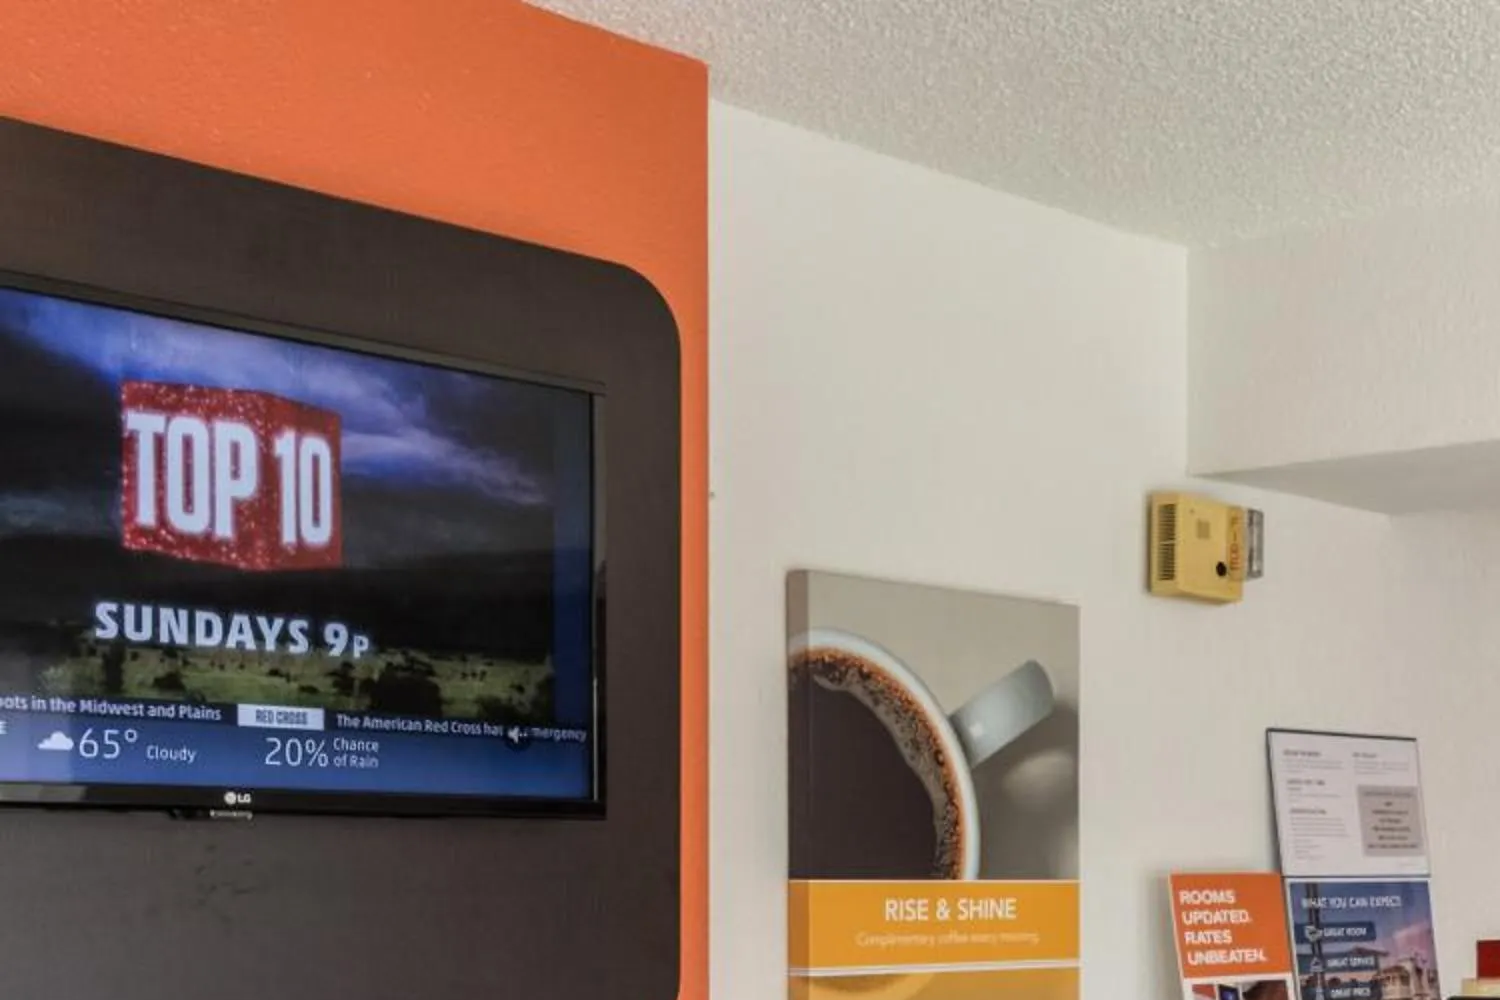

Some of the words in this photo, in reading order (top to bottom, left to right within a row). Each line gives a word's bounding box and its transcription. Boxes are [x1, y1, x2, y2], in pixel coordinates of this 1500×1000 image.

[126, 409, 259, 542] TOP
[274, 426, 333, 549] 10
[95, 602, 310, 655] SUNDAYS
[31, 696, 46, 711] in
[50, 699, 76, 714] the
[79, 700, 145, 717] Midwest
[147, 704, 176, 719] and
[178, 705, 222, 721] Plains
[256, 709, 274, 724] RED
[276, 711, 308, 725] CROSS
[336, 713, 360, 728] The
[362, 715, 422, 733] American
[424, 719, 449, 733] Red
[450, 720, 482, 735] Cross
[79, 727, 138, 760] 65°
[146, 744, 197, 764] Cloudy
[265, 736, 329, 768] 20%
[332, 737, 380, 752] Chance
[332, 754, 348, 769] of
[349, 754, 380, 769] Rain
[1178, 889, 1237, 905] ROOMS
[884, 898, 930, 922] RISE
[936, 898, 951, 922] &
[957, 898, 1018, 921] SHINE
[1182, 909, 1253, 925] UPDATED.
[1183, 929, 1233, 945] RATES
